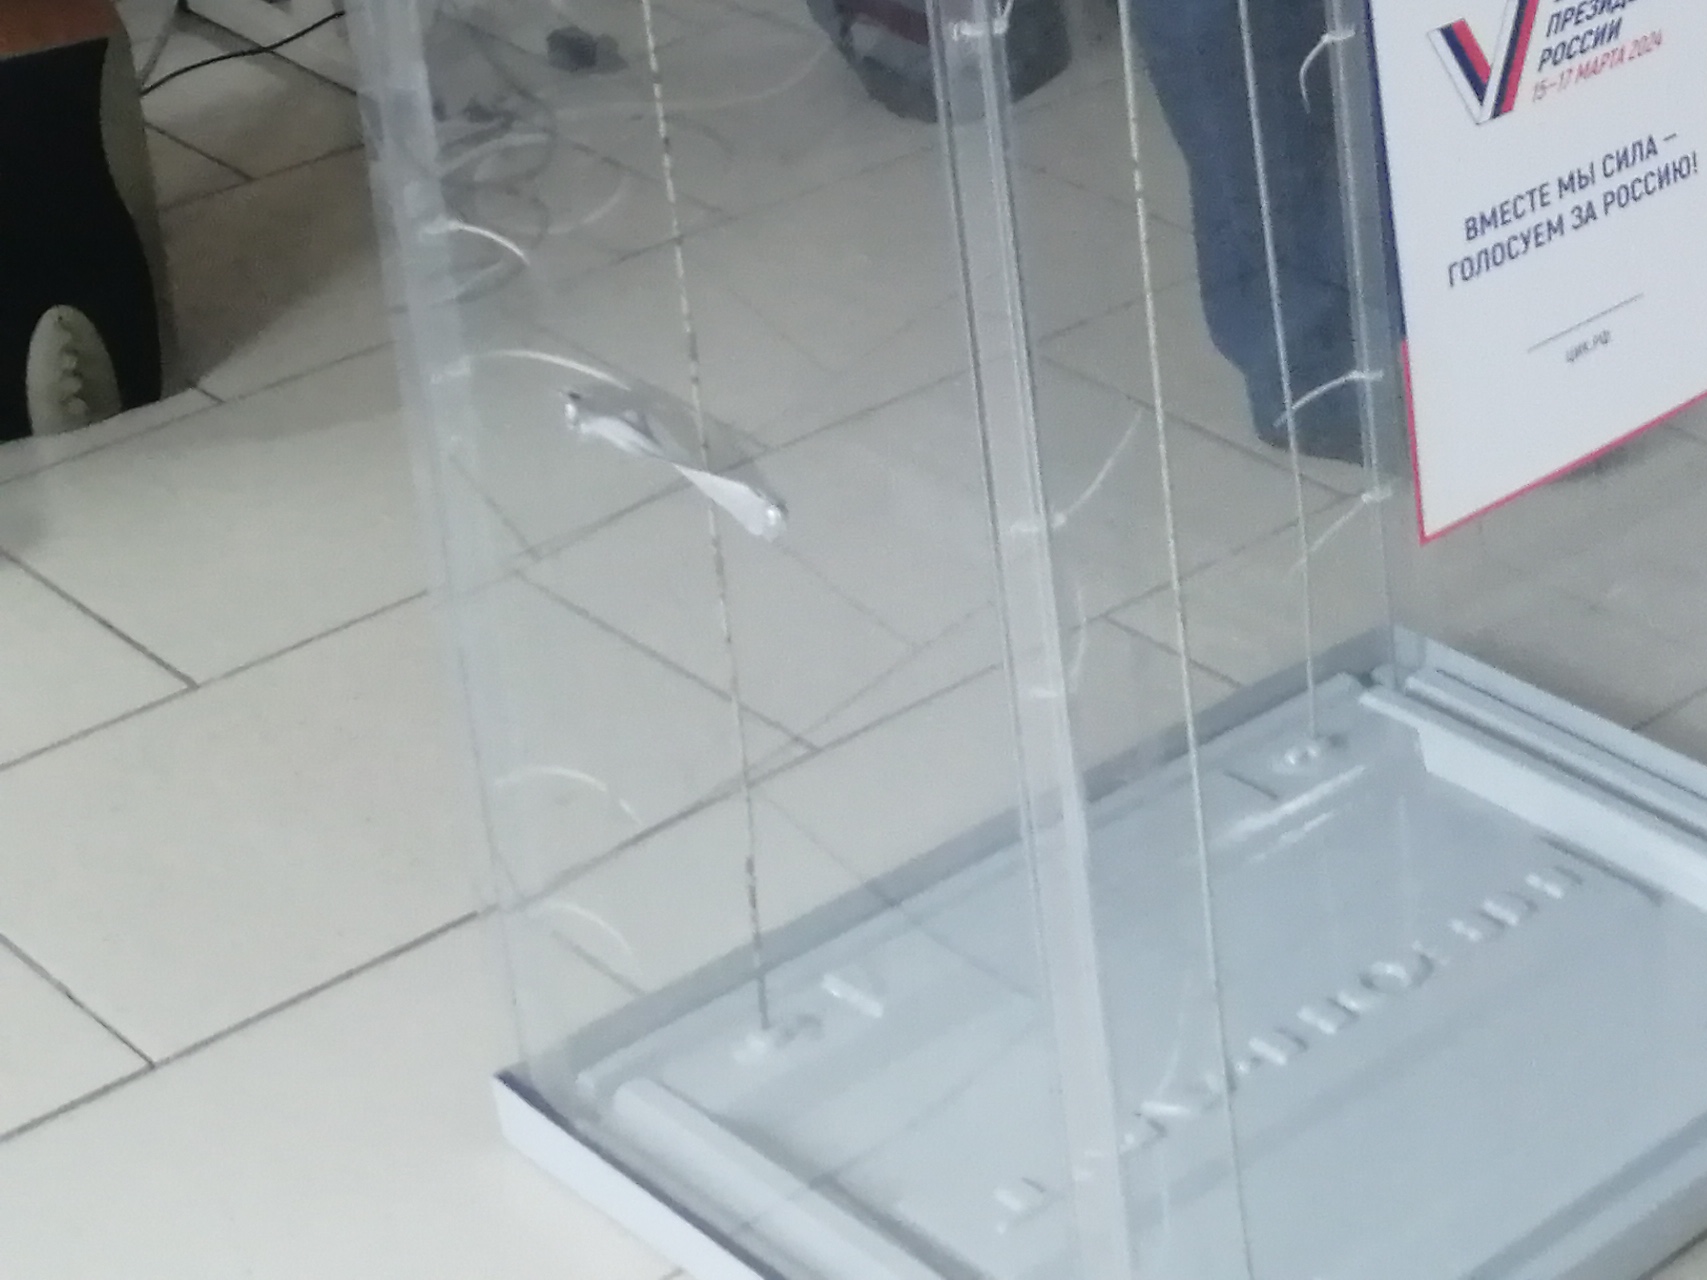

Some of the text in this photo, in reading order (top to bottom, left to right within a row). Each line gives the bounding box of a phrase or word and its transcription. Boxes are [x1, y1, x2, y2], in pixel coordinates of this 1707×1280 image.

[1538, 17, 1623, 72] РОССИИ
[1575, 47, 1625, 84] МАРТА
[1628, 29, 1663, 61] 2024
[1464, 140, 1661, 242] ВМЕСТЕ МЫ СИЛА
[1448, 150, 1700, 288] ГОЛОСУЕМ ЗА РОССИЮ!
[1566, 329, 1613, 364] ЦИК.РФ
